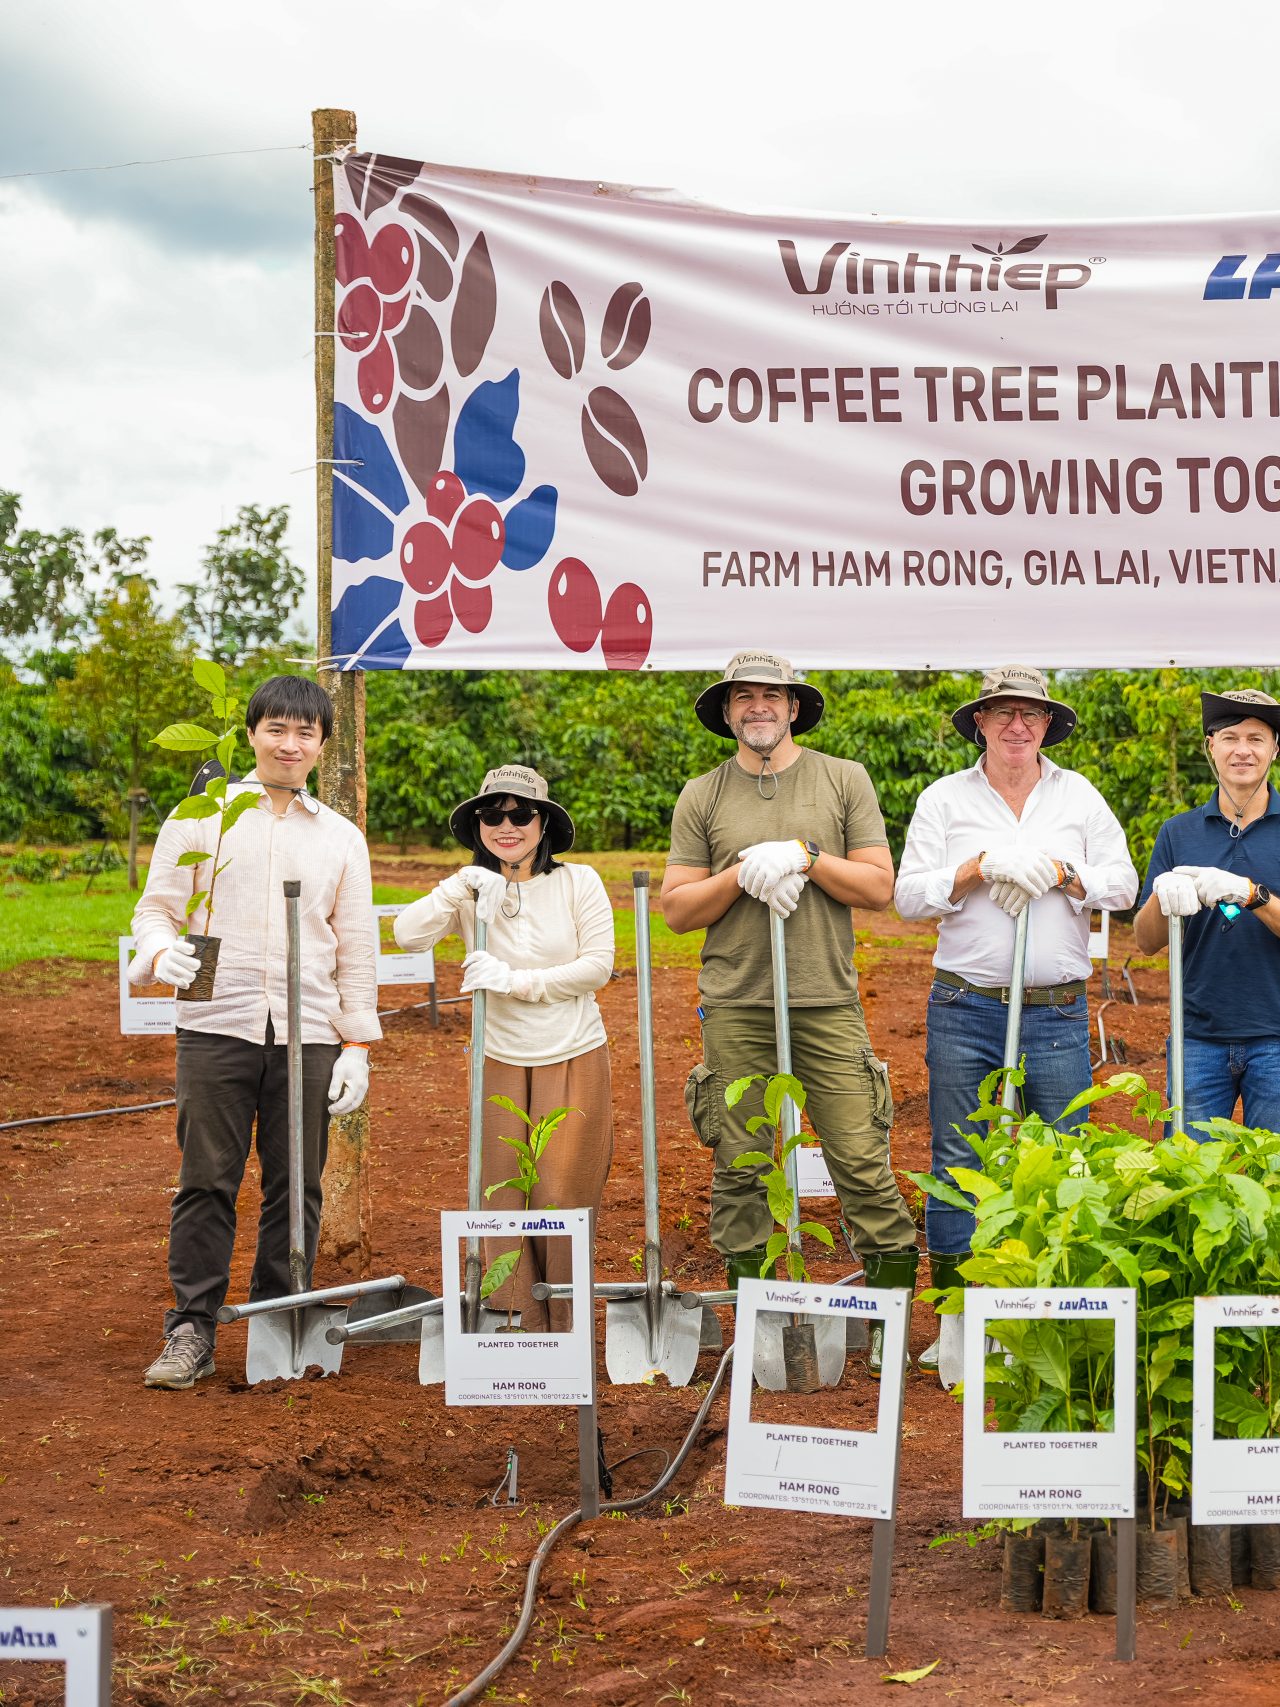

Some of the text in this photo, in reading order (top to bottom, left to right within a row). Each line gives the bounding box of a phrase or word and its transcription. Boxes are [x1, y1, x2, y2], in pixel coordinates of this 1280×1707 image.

[688, 367, 902, 423] COFFEE
[914, 366, 1059, 422] TREE
[901, 458, 1162, 516] GROWING
[703, 551, 799, 587] FARM
[812, 551, 890, 586] HAM
[904, 550, 1012, 589] RONG,
[1024, 550, 1085, 585] GIA
[1094, 550, 1160, 588] LAI,
[522, 1219, 565, 1230] LAVAZZA
[829, 1296, 877, 1311] LAVAZZA
[1059, 1298, 1108, 1310] LAVAZZA
[493, 1382, 515, 1390] HAM
[767, 1433, 858, 1447] PLANTED TOGETHER
[780, 1482, 839, 1495] HAM RONG
[1020, 1490, 1081, 1498] HAM RONG
[738, 1492, 789, 1502] COORDINATES:
[1248, 1496, 1273, 1504] HAM
